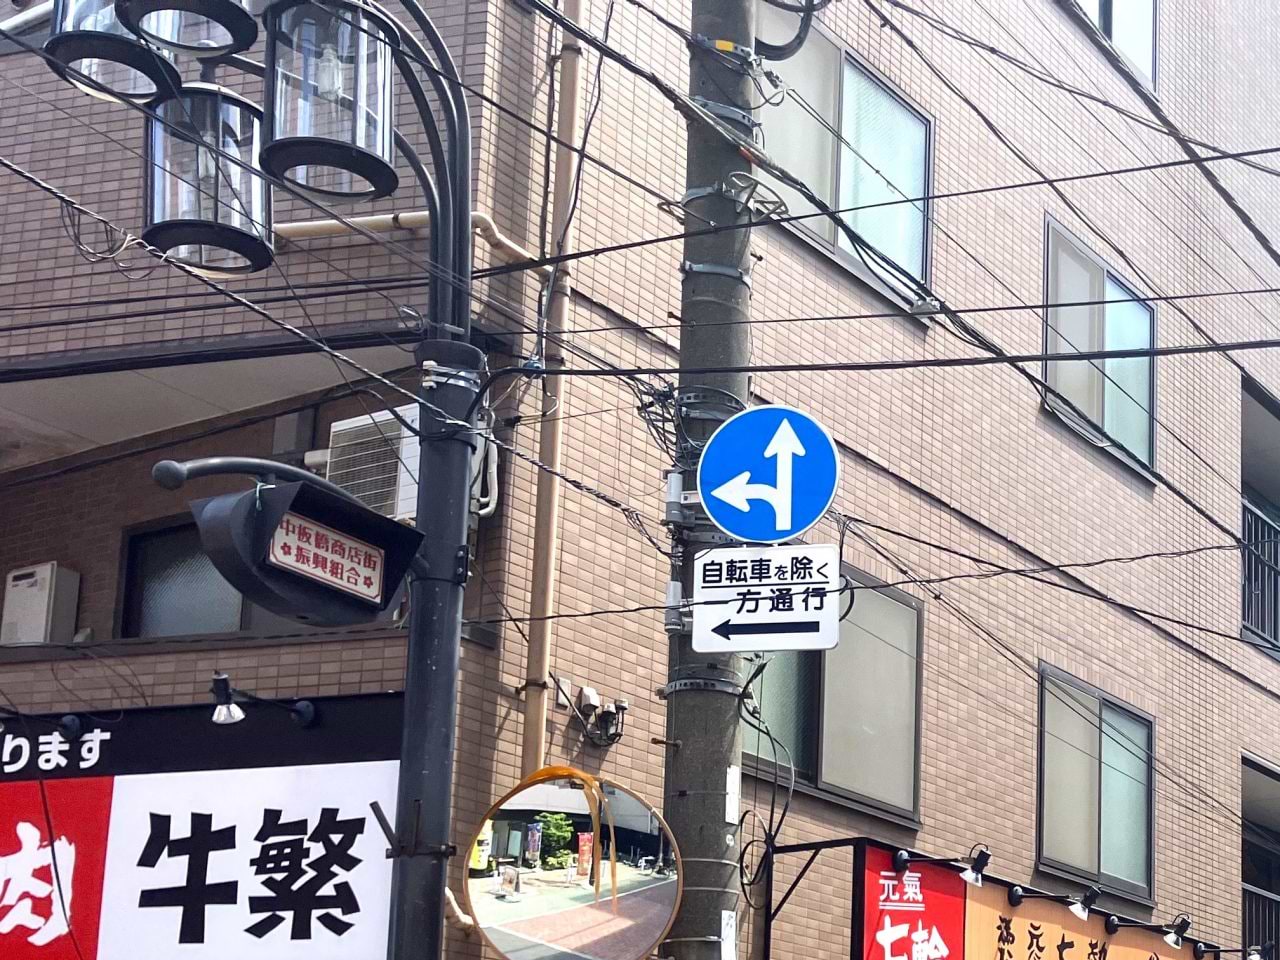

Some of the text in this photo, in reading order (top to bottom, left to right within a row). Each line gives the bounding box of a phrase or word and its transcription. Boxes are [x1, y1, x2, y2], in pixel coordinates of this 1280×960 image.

[279, 518, 378, 572] 中板橋商店街
[295, 546, 361, 586] 振興組合
[702, 557, 829, 583] 自転車を除く
[703, 587, 828, 614] 一方通行
[136, 807, 366, 944] 牛繁
[879, 870, 924, 902] 元氣
